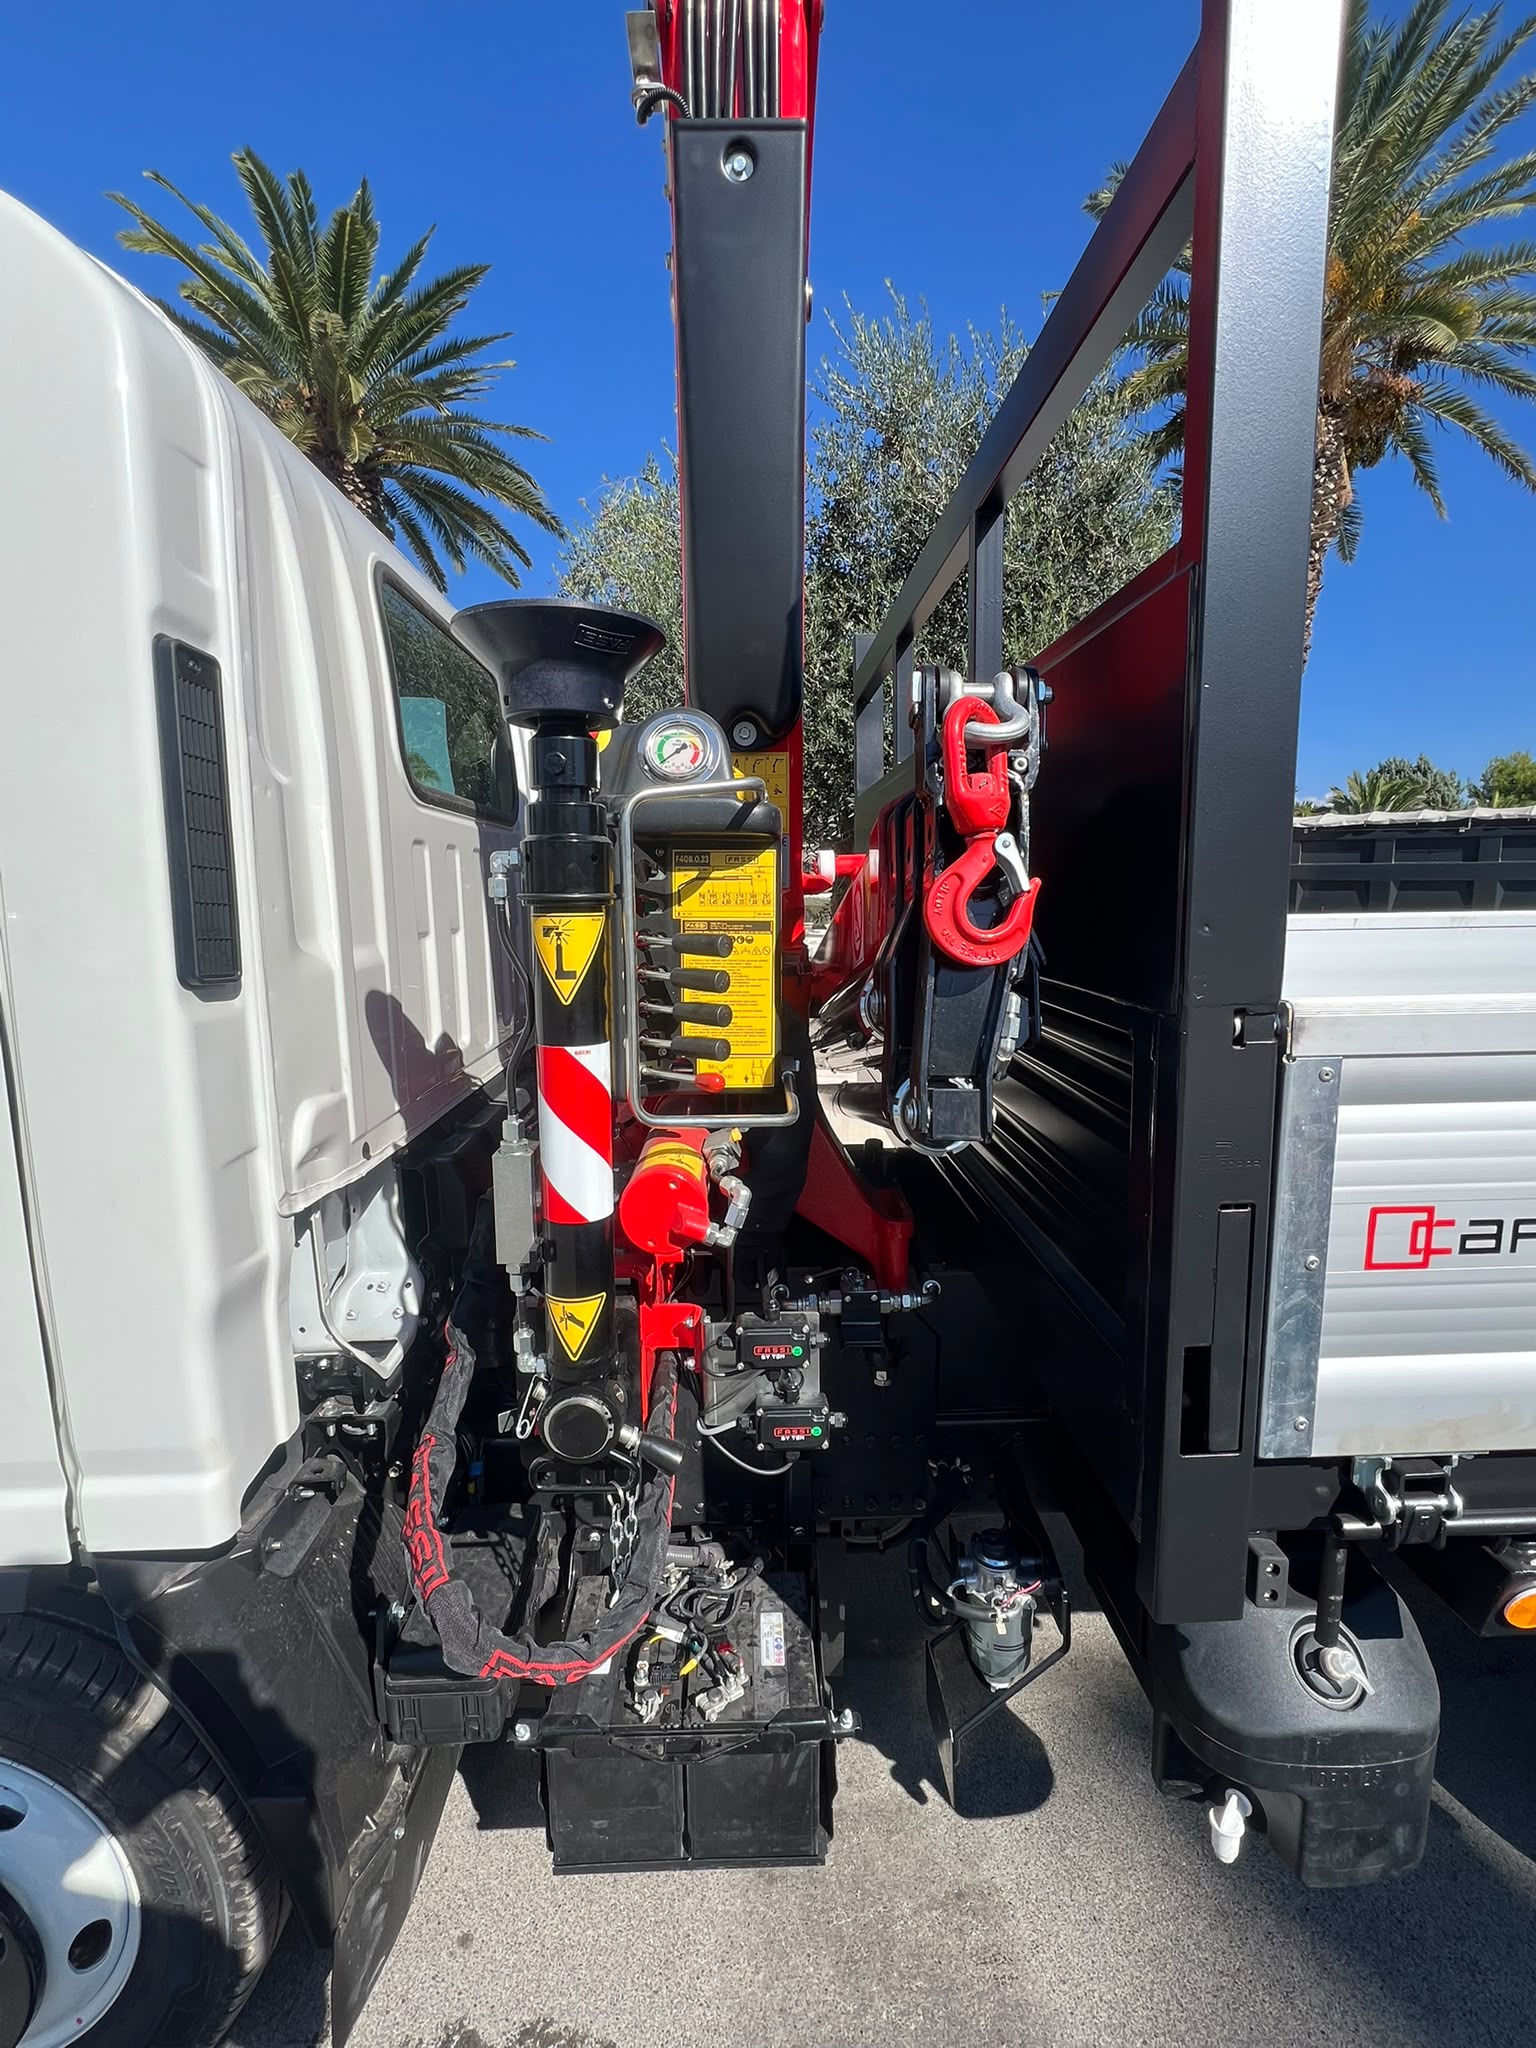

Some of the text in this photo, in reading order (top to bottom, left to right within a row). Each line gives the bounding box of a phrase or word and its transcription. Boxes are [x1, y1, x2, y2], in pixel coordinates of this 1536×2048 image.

[727, 855, 758, 864] FASSI
[756, 1346, 791, 1354] FASSI
[776, 1428, 810, 1436] FASSI
